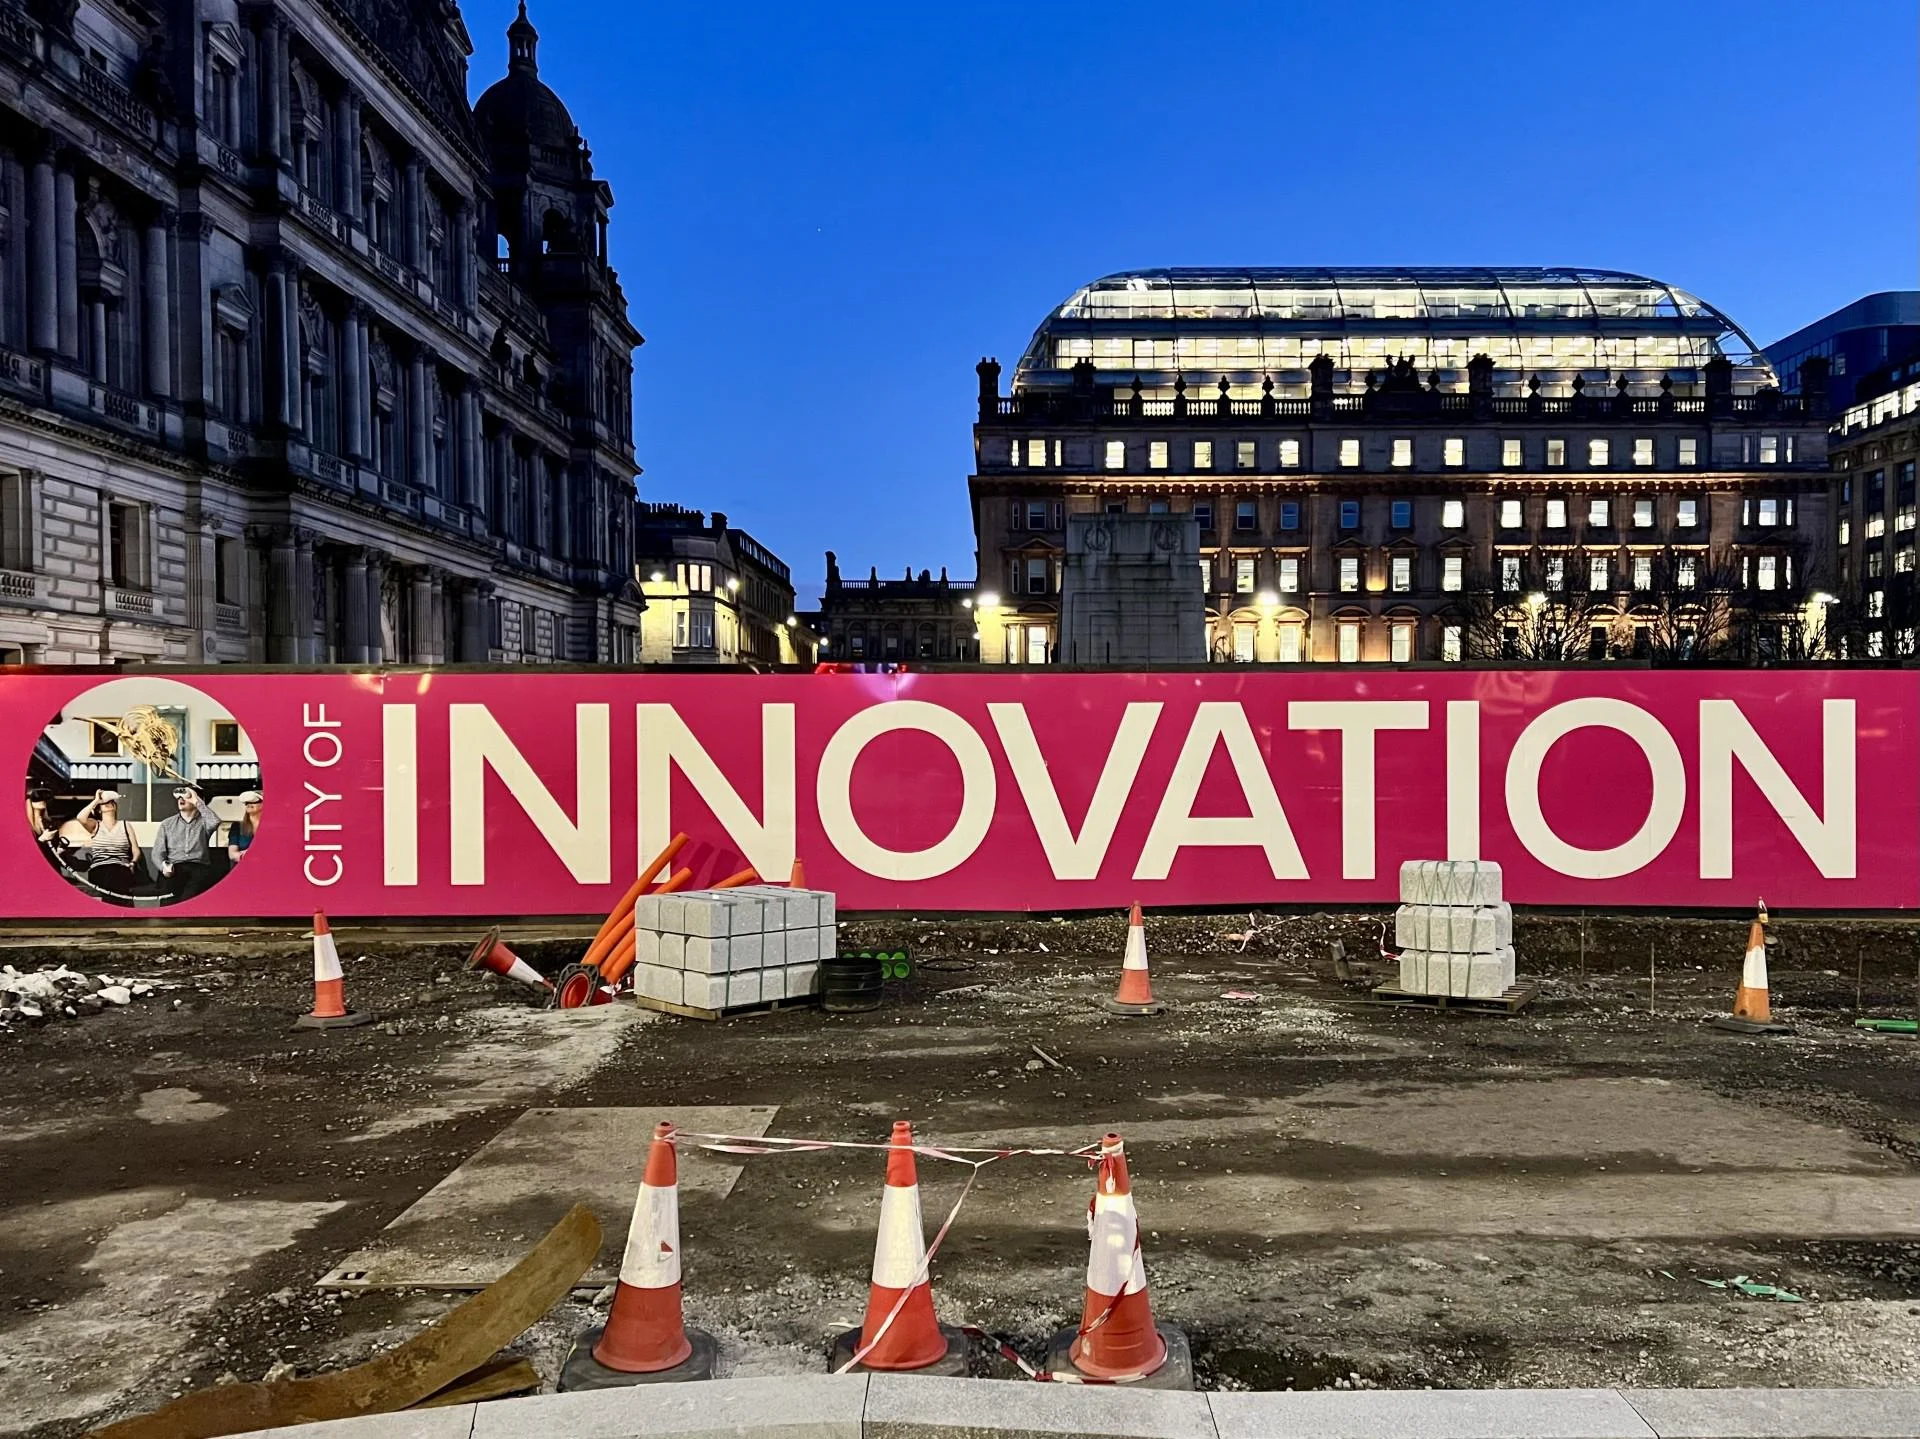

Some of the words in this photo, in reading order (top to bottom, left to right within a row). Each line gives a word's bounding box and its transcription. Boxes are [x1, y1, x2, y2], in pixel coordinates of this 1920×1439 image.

[303, 703, 343, 767] OF
[303, 781, 343, 886] CITY
[382, 698, 1857, 886] INNOVATION
